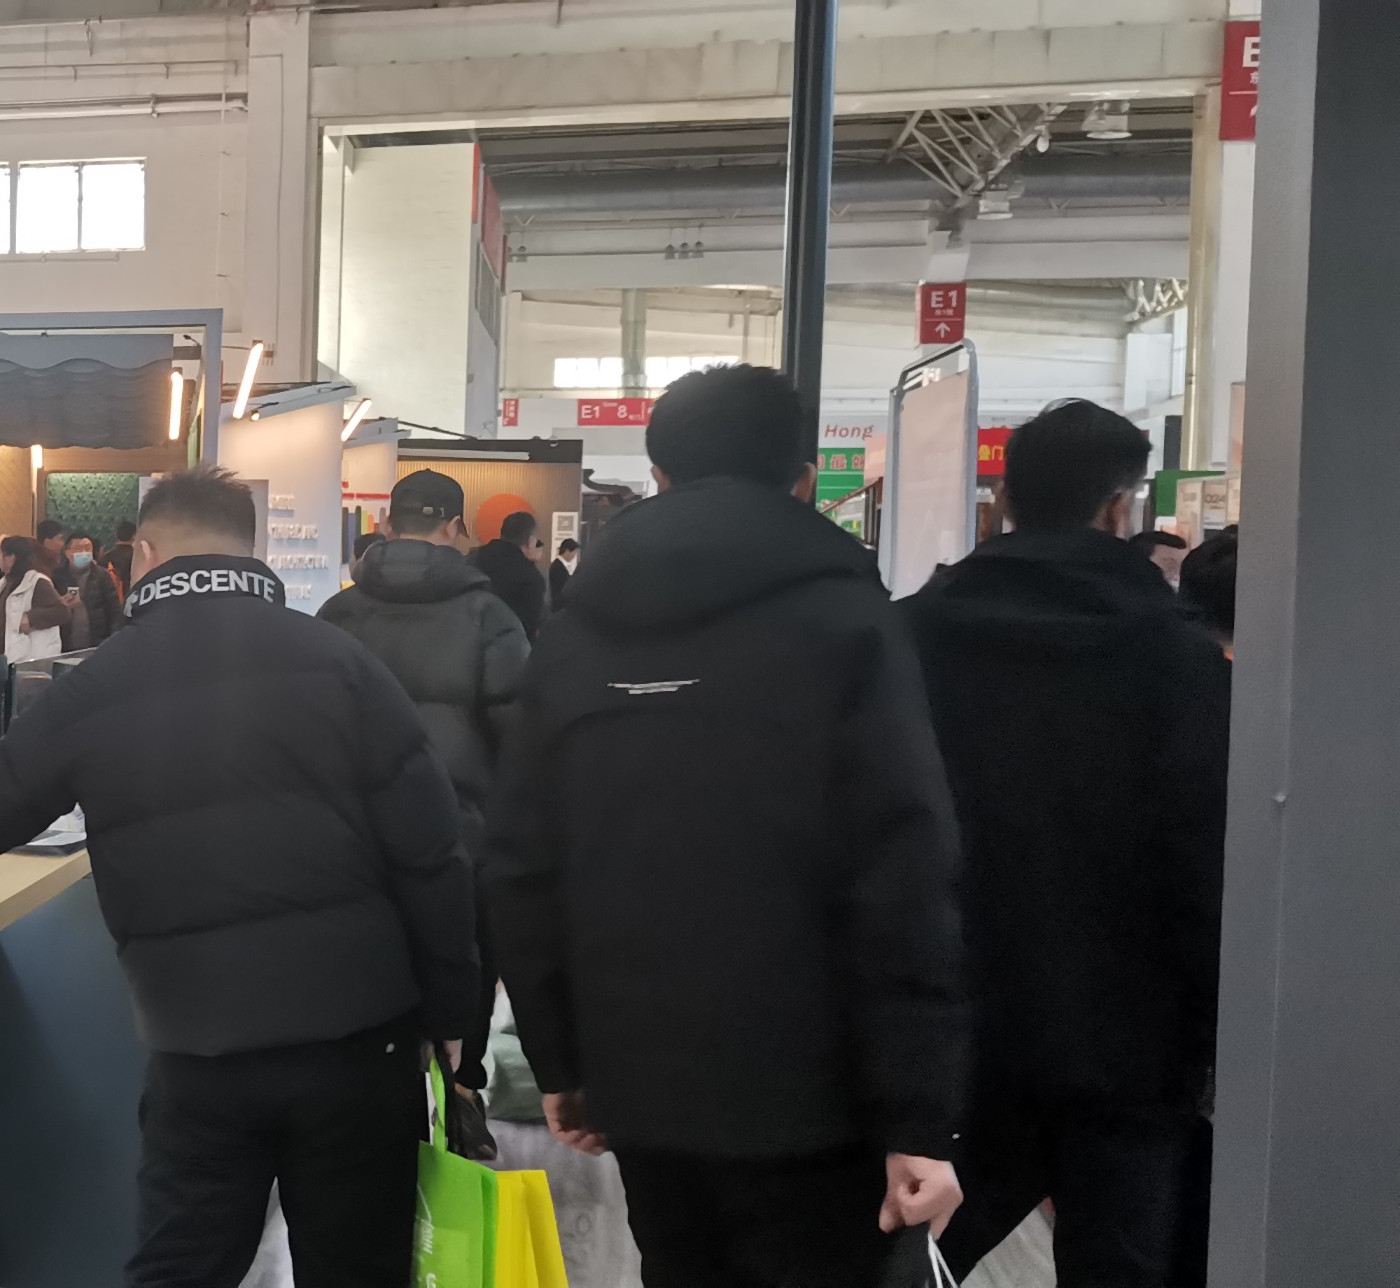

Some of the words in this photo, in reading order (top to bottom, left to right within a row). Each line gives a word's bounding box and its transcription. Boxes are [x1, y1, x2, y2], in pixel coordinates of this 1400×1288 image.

[931, 290, 957, 308] E1
[581, 404, 600, 419] E1
[617, 404, 628, 419] 8
[824, 424, 874, 441] Hong
[139, 569, 276, 604] DESCENTE
